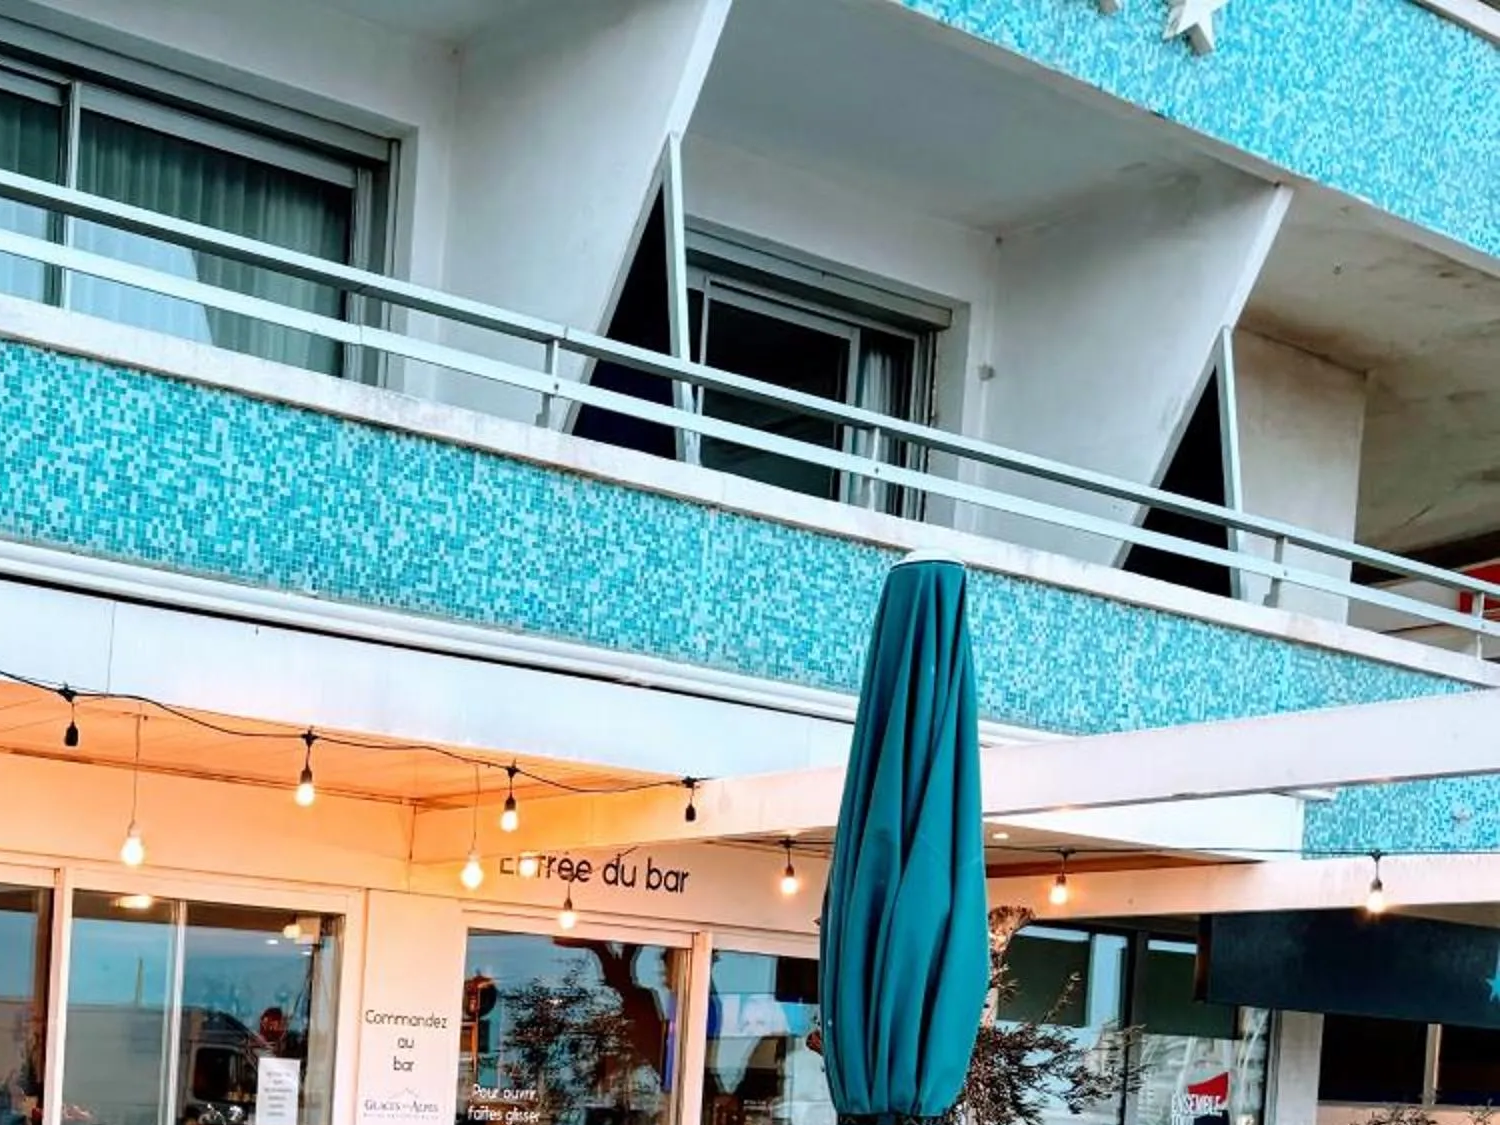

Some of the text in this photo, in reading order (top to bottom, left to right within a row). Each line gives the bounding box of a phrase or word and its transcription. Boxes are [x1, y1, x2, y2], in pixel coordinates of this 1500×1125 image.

[499, 851, 690, 894] Etrée du bar
[364, 1009, 449, 1029] Commandez
[397, 1037, 415, 1050] au
[392, 1056, 415, 1072] bar
[472, 1083, 499, 1100] Pour
